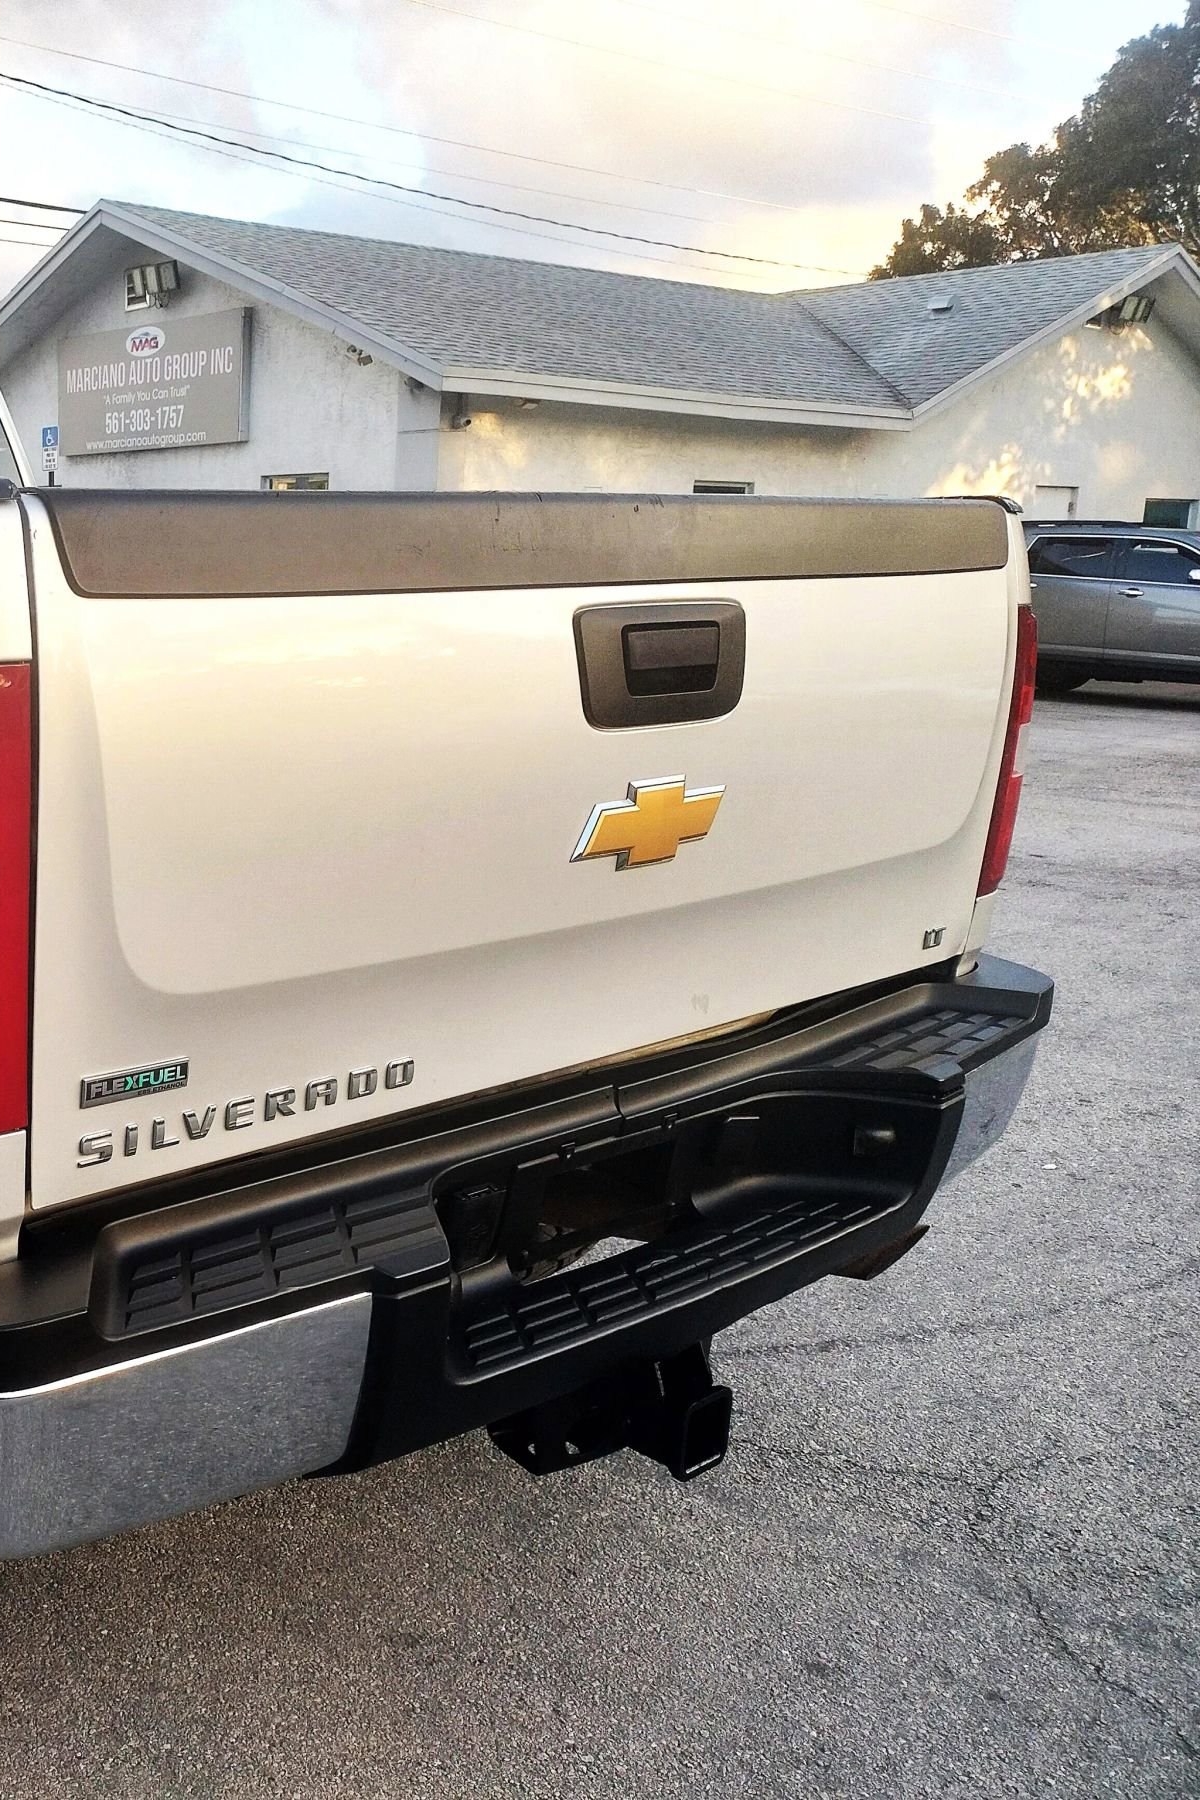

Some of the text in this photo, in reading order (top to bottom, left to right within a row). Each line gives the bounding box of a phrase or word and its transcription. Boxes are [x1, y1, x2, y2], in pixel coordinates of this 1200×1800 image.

[131, 336, 159, 353] MAG
[66, 346, 233, 394] MARCIANO AUTO GROUP INC
[112, 392, 136, 405] Family
[136, 390, 151, 402] You
[152, 388, 169, 400] Can
[105, 404, 185, 434] 561-303-1757
[86, 430, 207, 451] www.marcianoautogroup.com
[922, 927, 947, 950] LT
[90, 1065, 186, 1099] FLEXFUEL
[77, 1056, 416, 1169] SILVERADO
